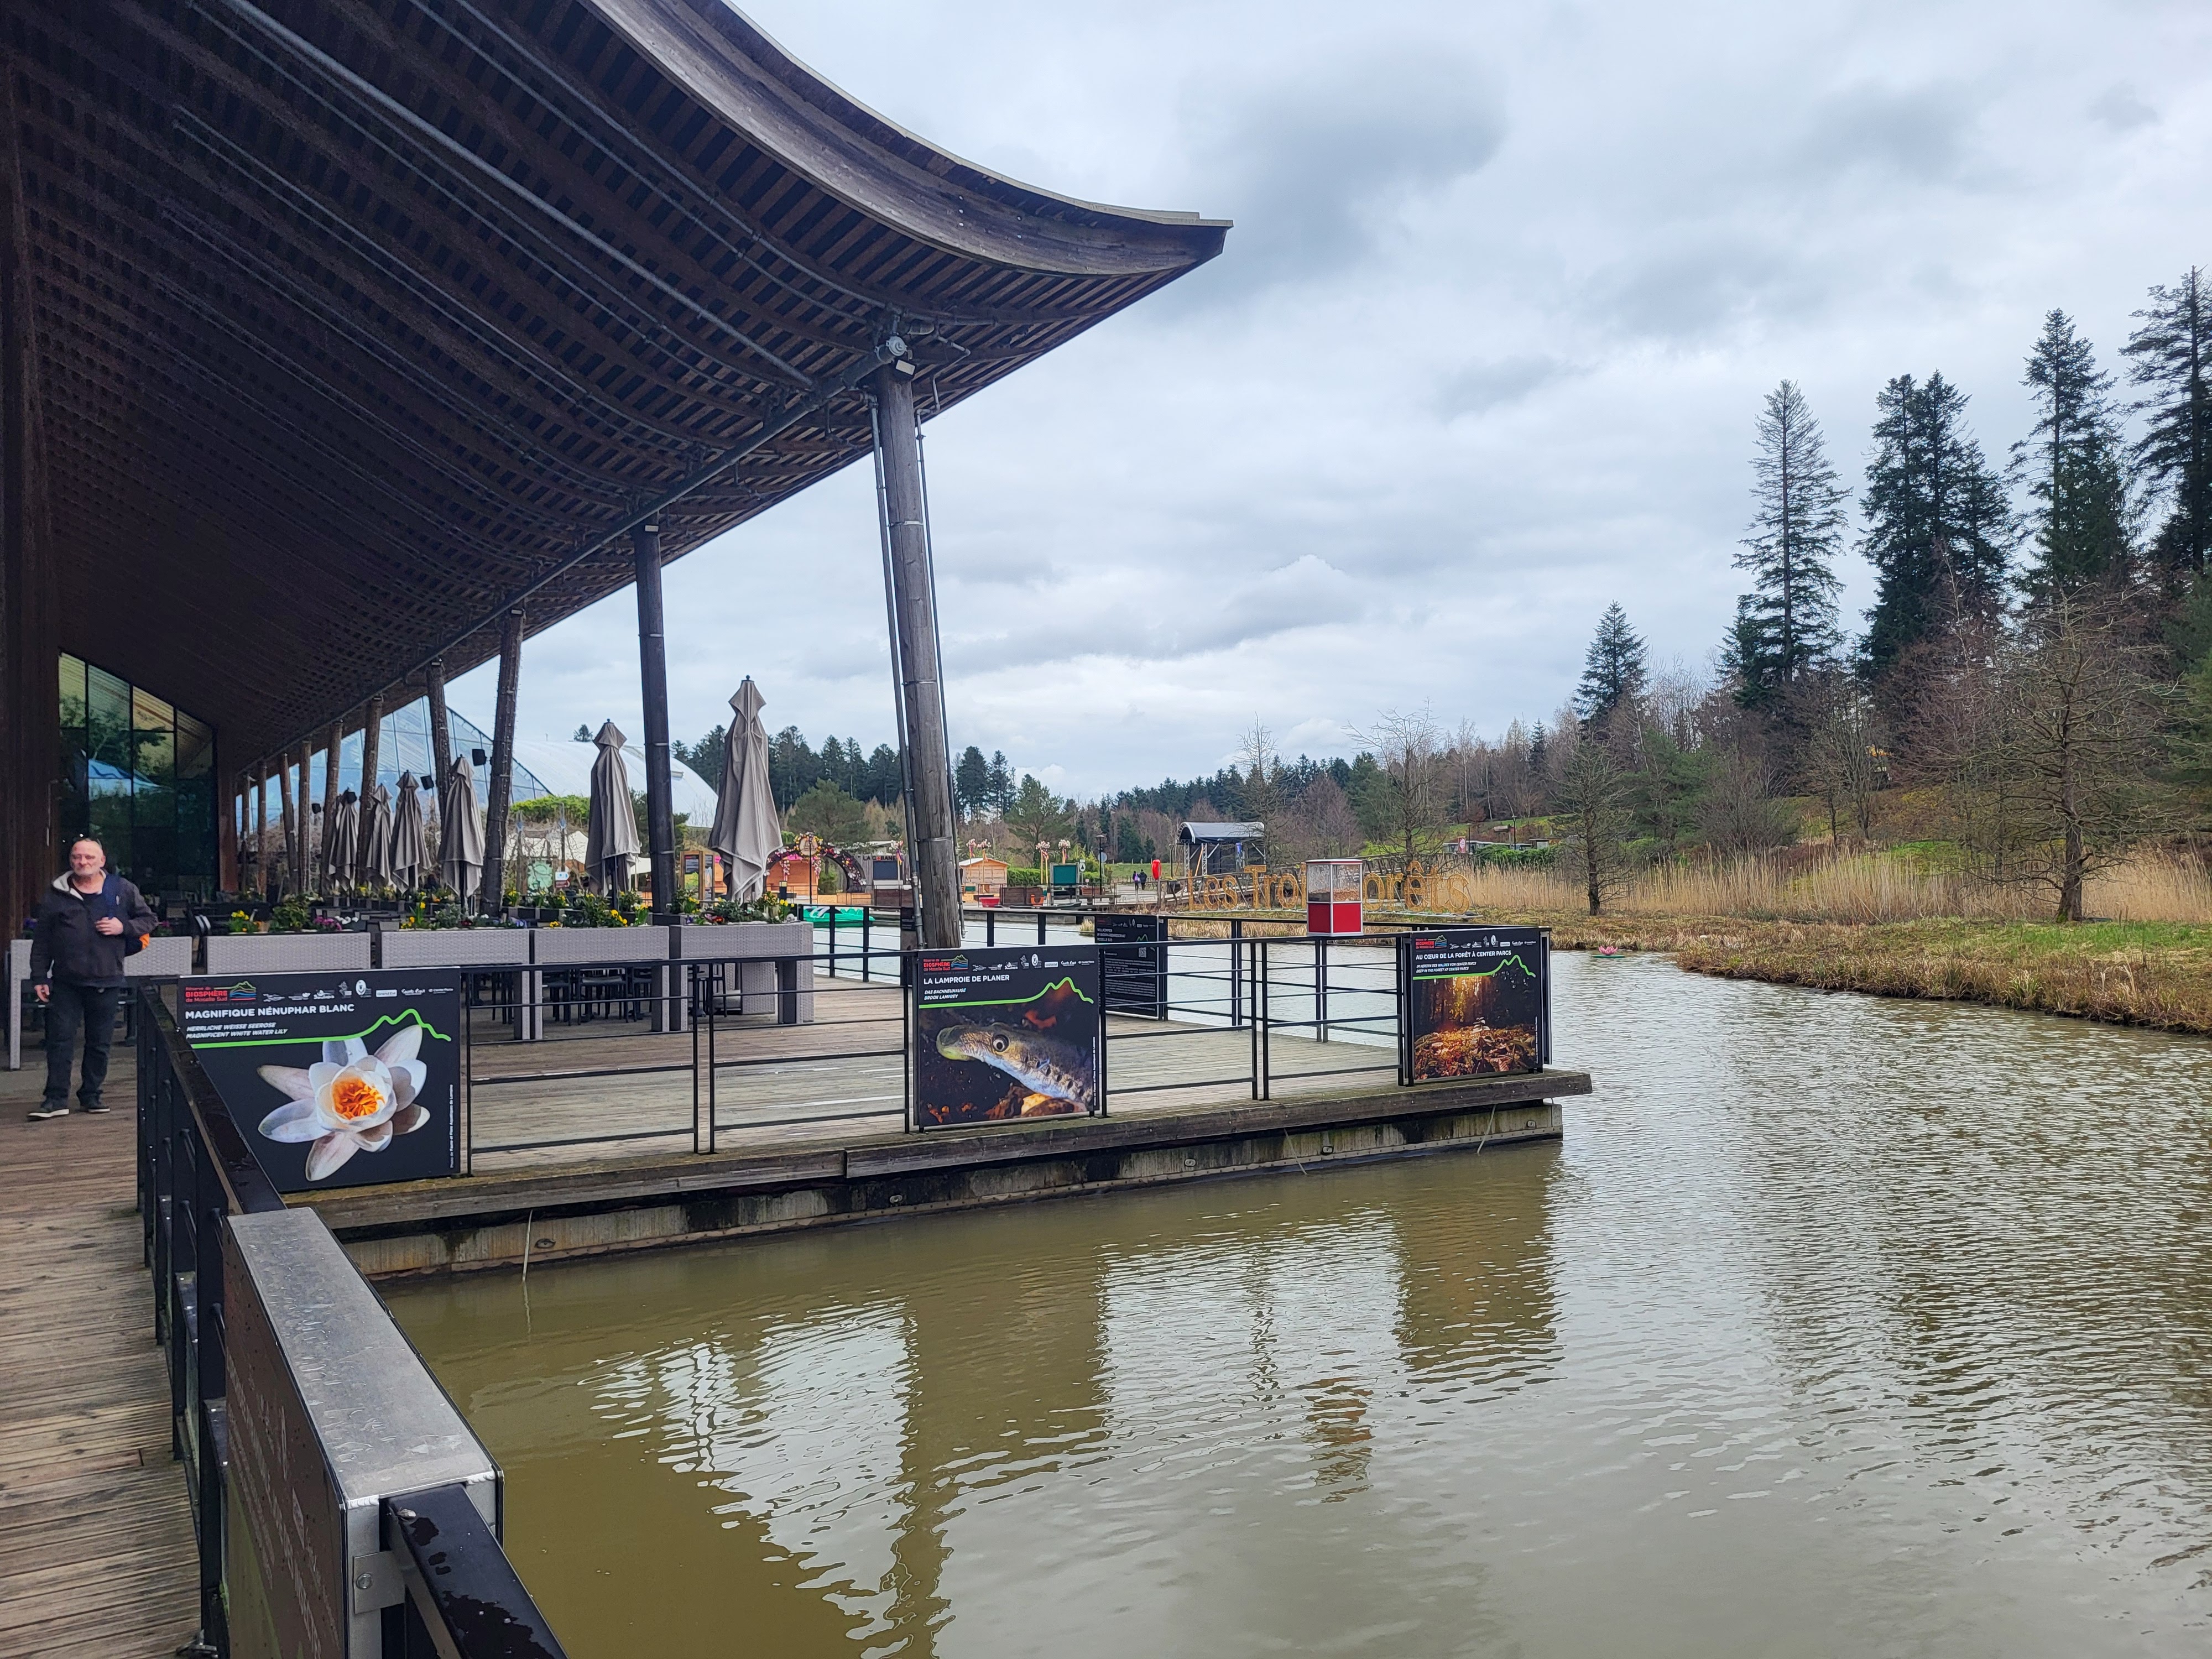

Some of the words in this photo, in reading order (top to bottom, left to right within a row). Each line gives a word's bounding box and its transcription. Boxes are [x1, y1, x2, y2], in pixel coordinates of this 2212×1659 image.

[1188, 869, 1238, 910] Les
[1244, 862, 1307, 909] Troi
[1363, 860, 1469, 914] orêts
[935, 976, 970, 984] LAMPROIE
[185, 1008, 255, 1020] MAGNIFIQUE
[258, 1006, 317, 1016] NÉNUPHAR
[319, 1004, 354, 1014] BLANC
